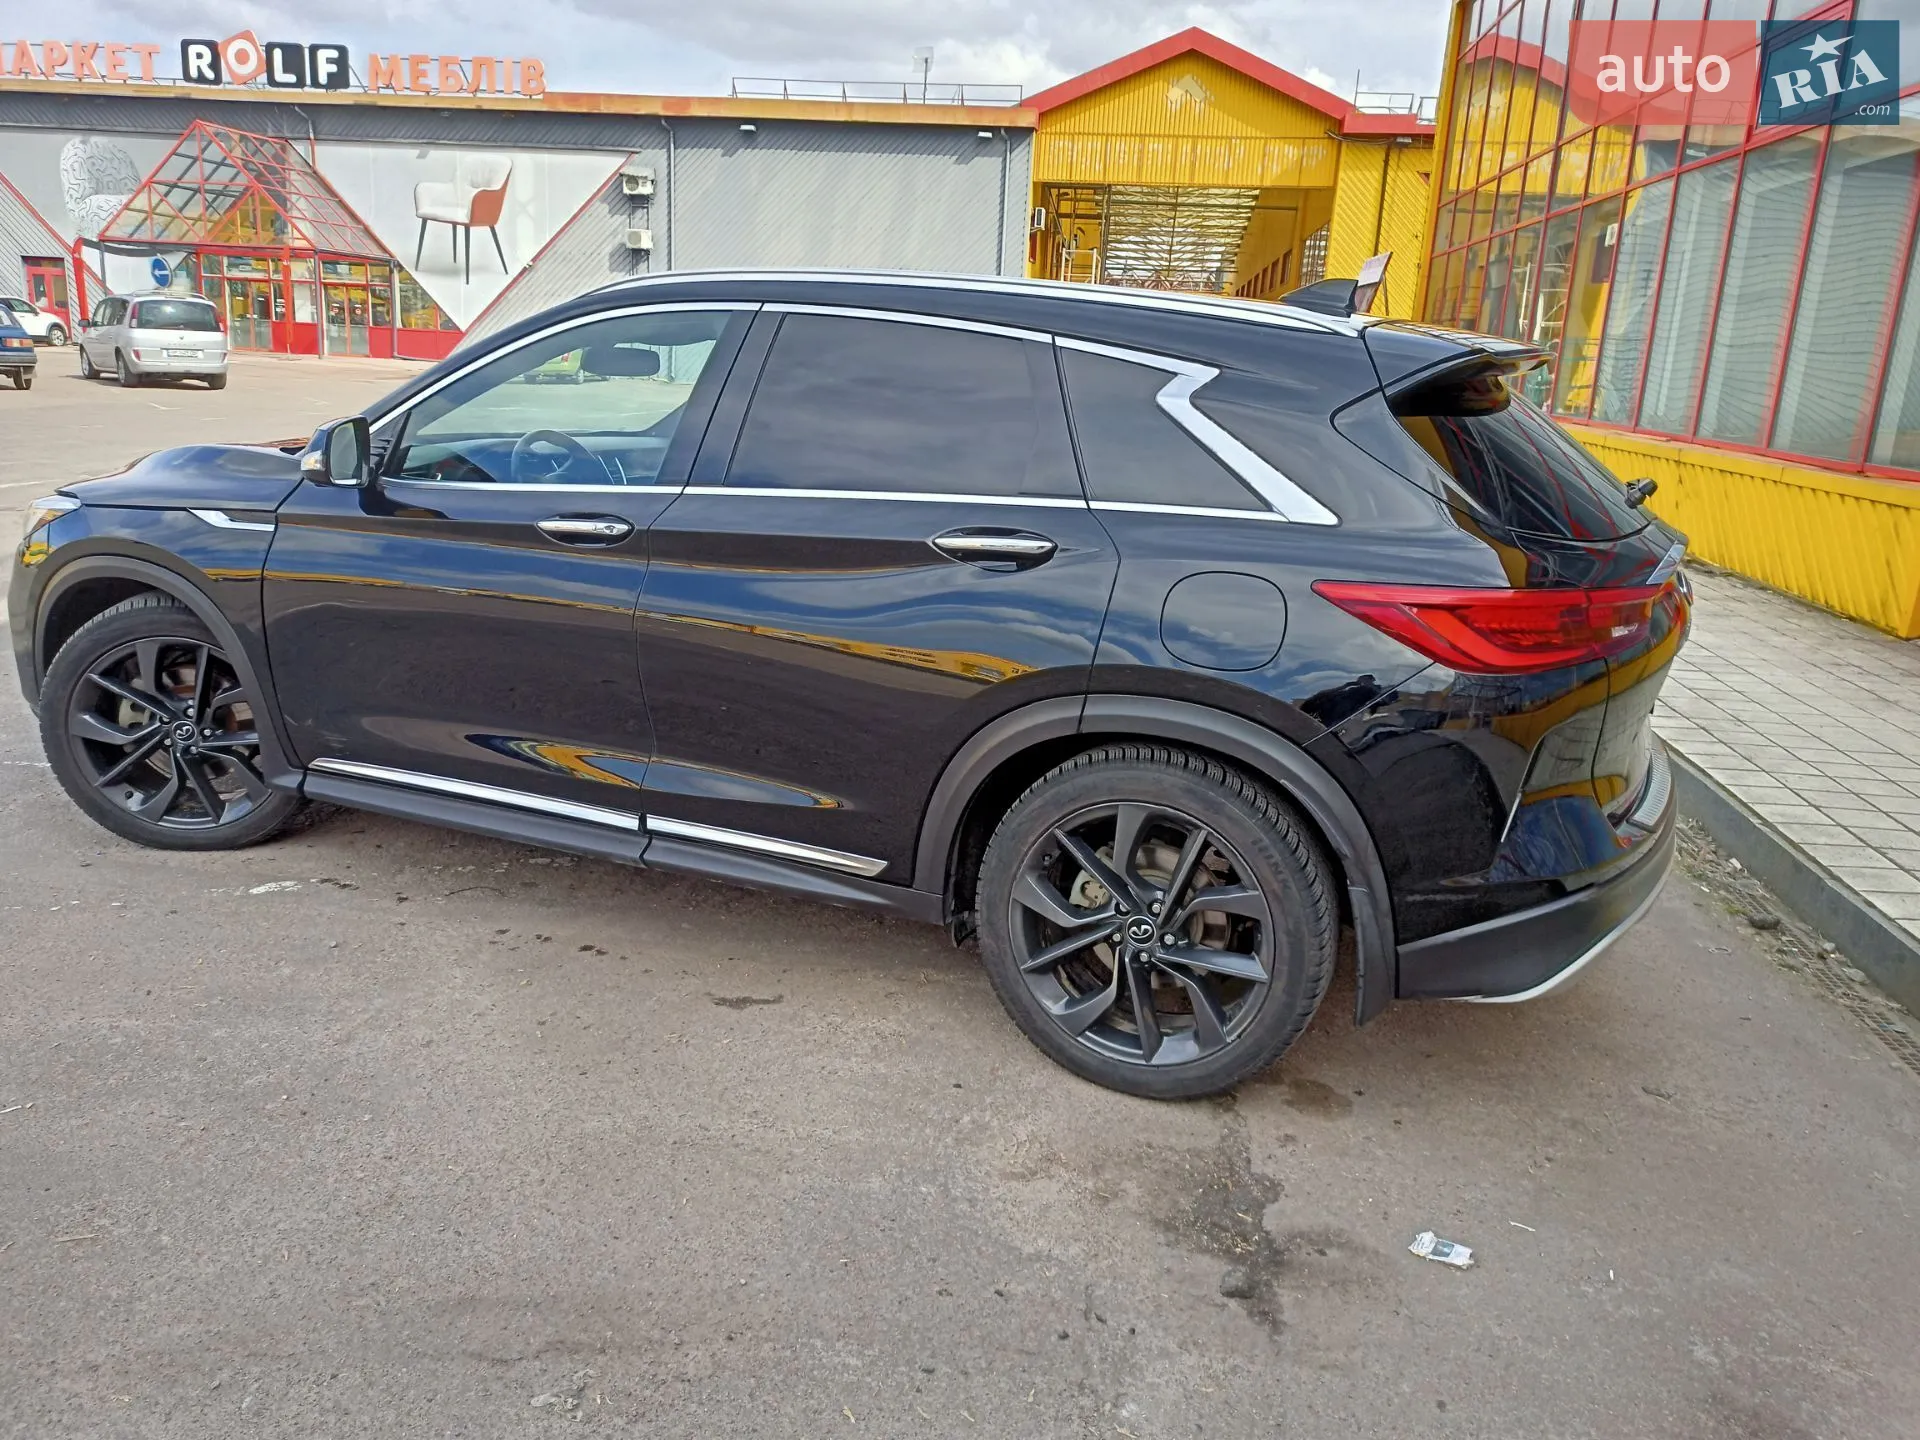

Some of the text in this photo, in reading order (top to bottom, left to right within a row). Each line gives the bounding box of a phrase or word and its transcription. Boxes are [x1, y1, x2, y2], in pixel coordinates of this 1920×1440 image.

[0, 37, 547, 96] АРКЕТ ROLF МЕБЛІВ
